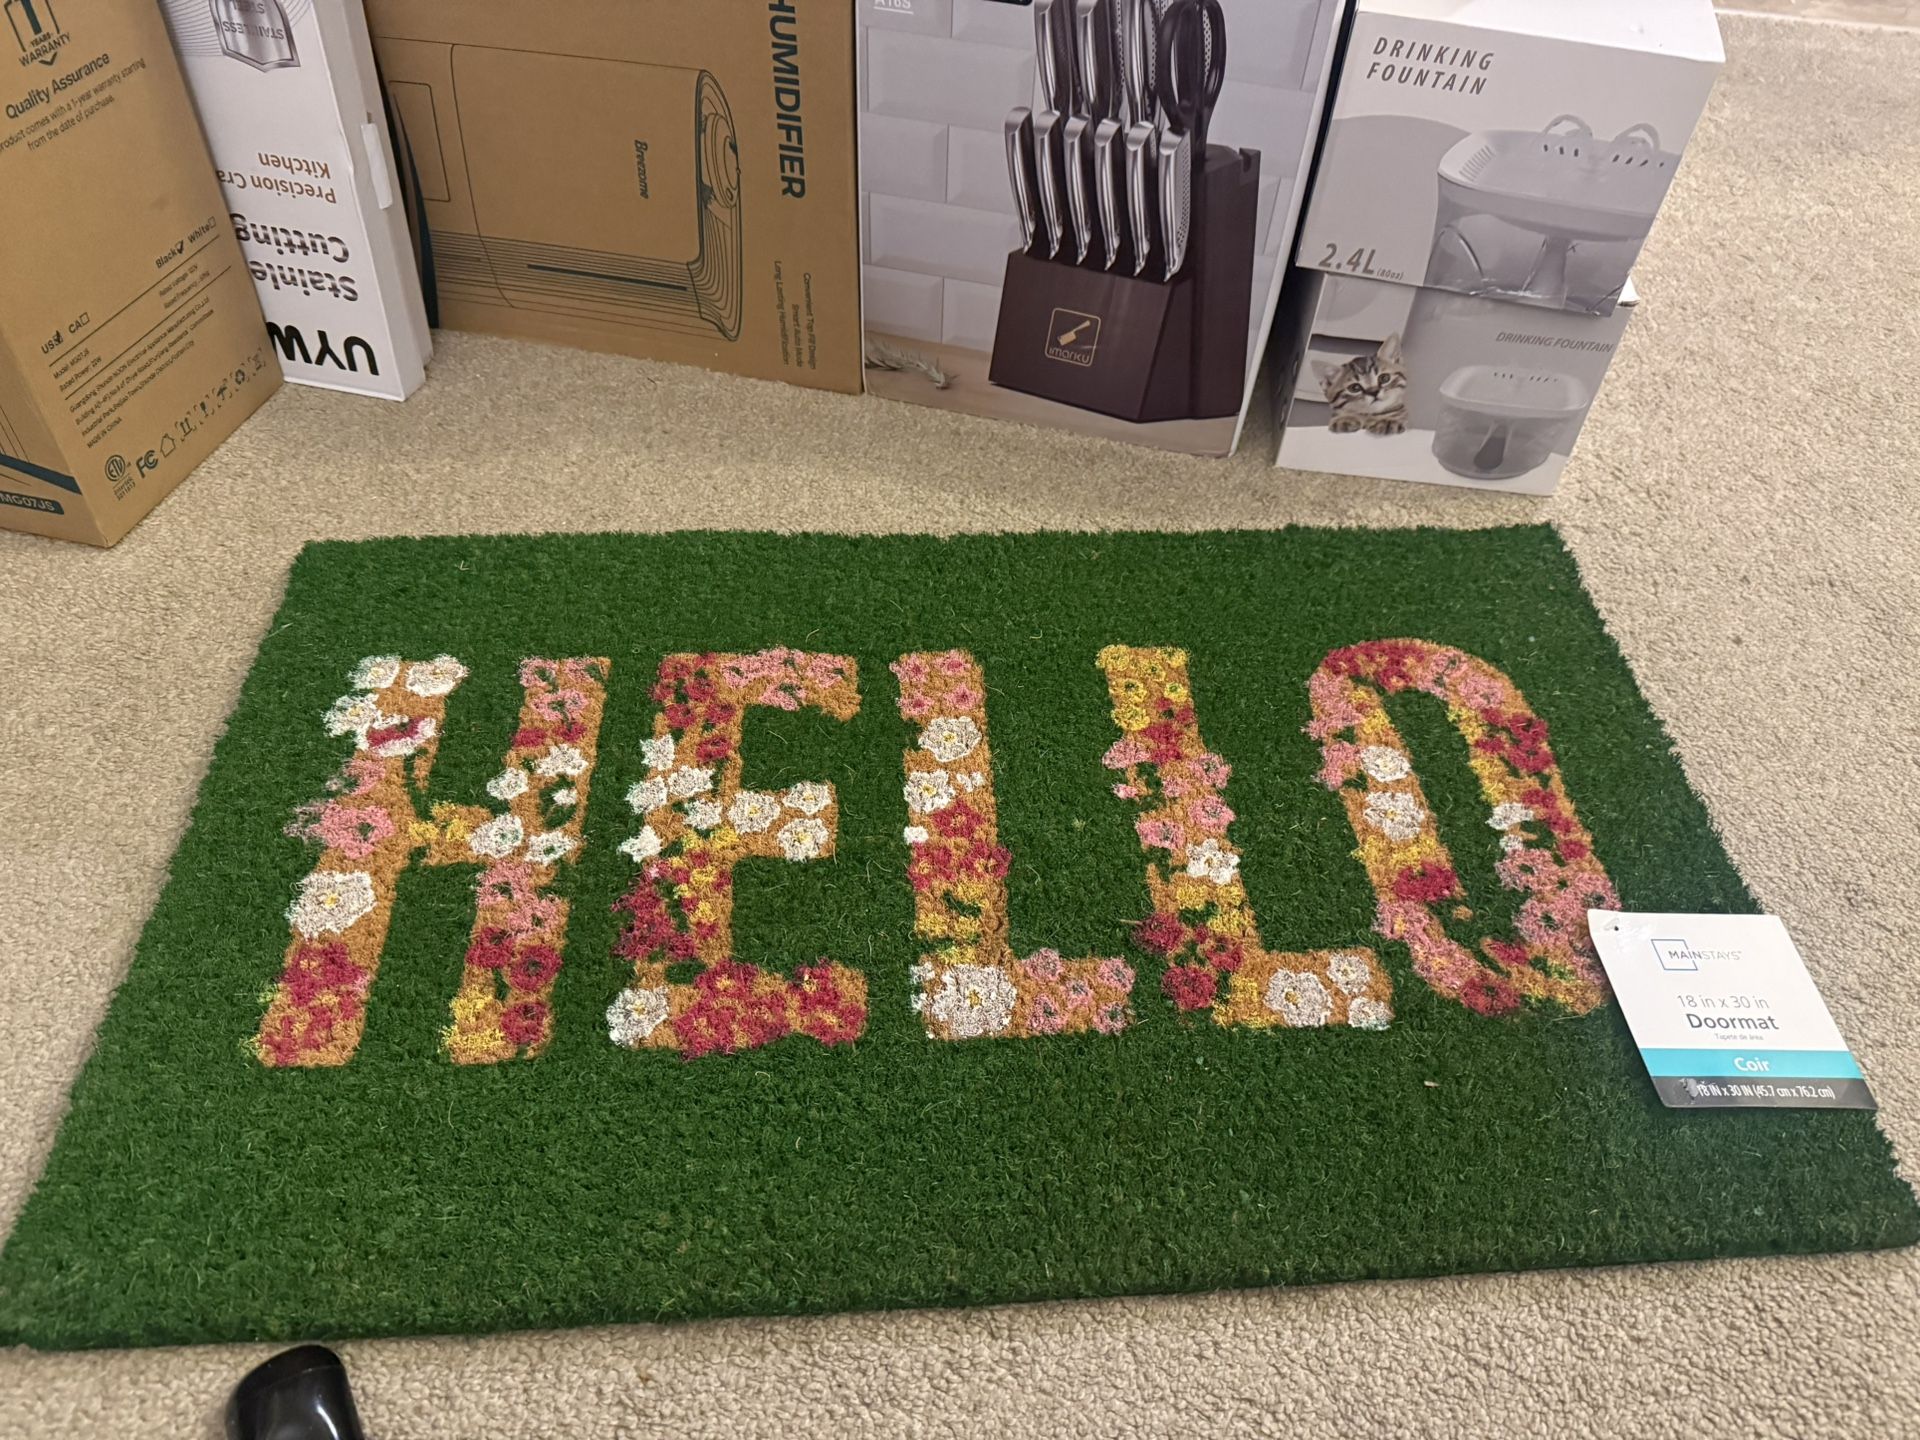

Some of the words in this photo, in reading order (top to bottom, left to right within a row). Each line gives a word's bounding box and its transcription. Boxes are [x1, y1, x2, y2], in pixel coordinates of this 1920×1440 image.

[19, 32, 71, 67] WARRANTY
[1373, 36, 1494, 71] DRINKING
[5, 86, 50, 119] Quality
[51, 53, 110, 94] Assurance
[1366, 61, 1488, 95] FOUNTAIN
[26, 115, 51, 135] comes
[49, 105, 67, 121] with
[72, 89, 92, 108] 1-year
[93, 71, 122, 95] warranty
[120, 57, 147, 78] starting
[27, 134, 48, 151] from
[46, 126, 60, 141] the
[59, 116, 76, 133] date
[76, 109, 84, 123] of
[257, 152, 331, 180] Kitchen
[250, 174, 337, 205] Precision
[155, 247, 179, 269] Black
[187, 222, 210, 244] White
[230, 213, 350, 263] Cutting
[1317, 243, 1376, 275] 2.4L
[249, 260, 359, 302] Stainle
[68, 319, 82, 334] CA
[1496, 331, 1555, 347] DRINKING
[1553, 338, 1614, 353] FOUNTAIN
[248, 637, 1619, 1067] HELLO
[1668, 949, 1741, 961] MAINSTAYS
[1677, 994, 1698, 1009] 18
[1699, 994, 1716, 1009] in
[1718, 998, 1729, 1009] x
[1730, 995, 1751, 1009] 30
[1752, 995, 1770, 1009] in
[1686, 1012, 1780, 1030] Doormat
[1733, 1056, 1771, 1073] Coir
[1727, 1084, 1741, 1097] 30
[1752, 1084, 1776, 1100] (45.7
[1776, 1087, 1791, 1098] cm
[1818, 1085, 1837, 1101] cm)
